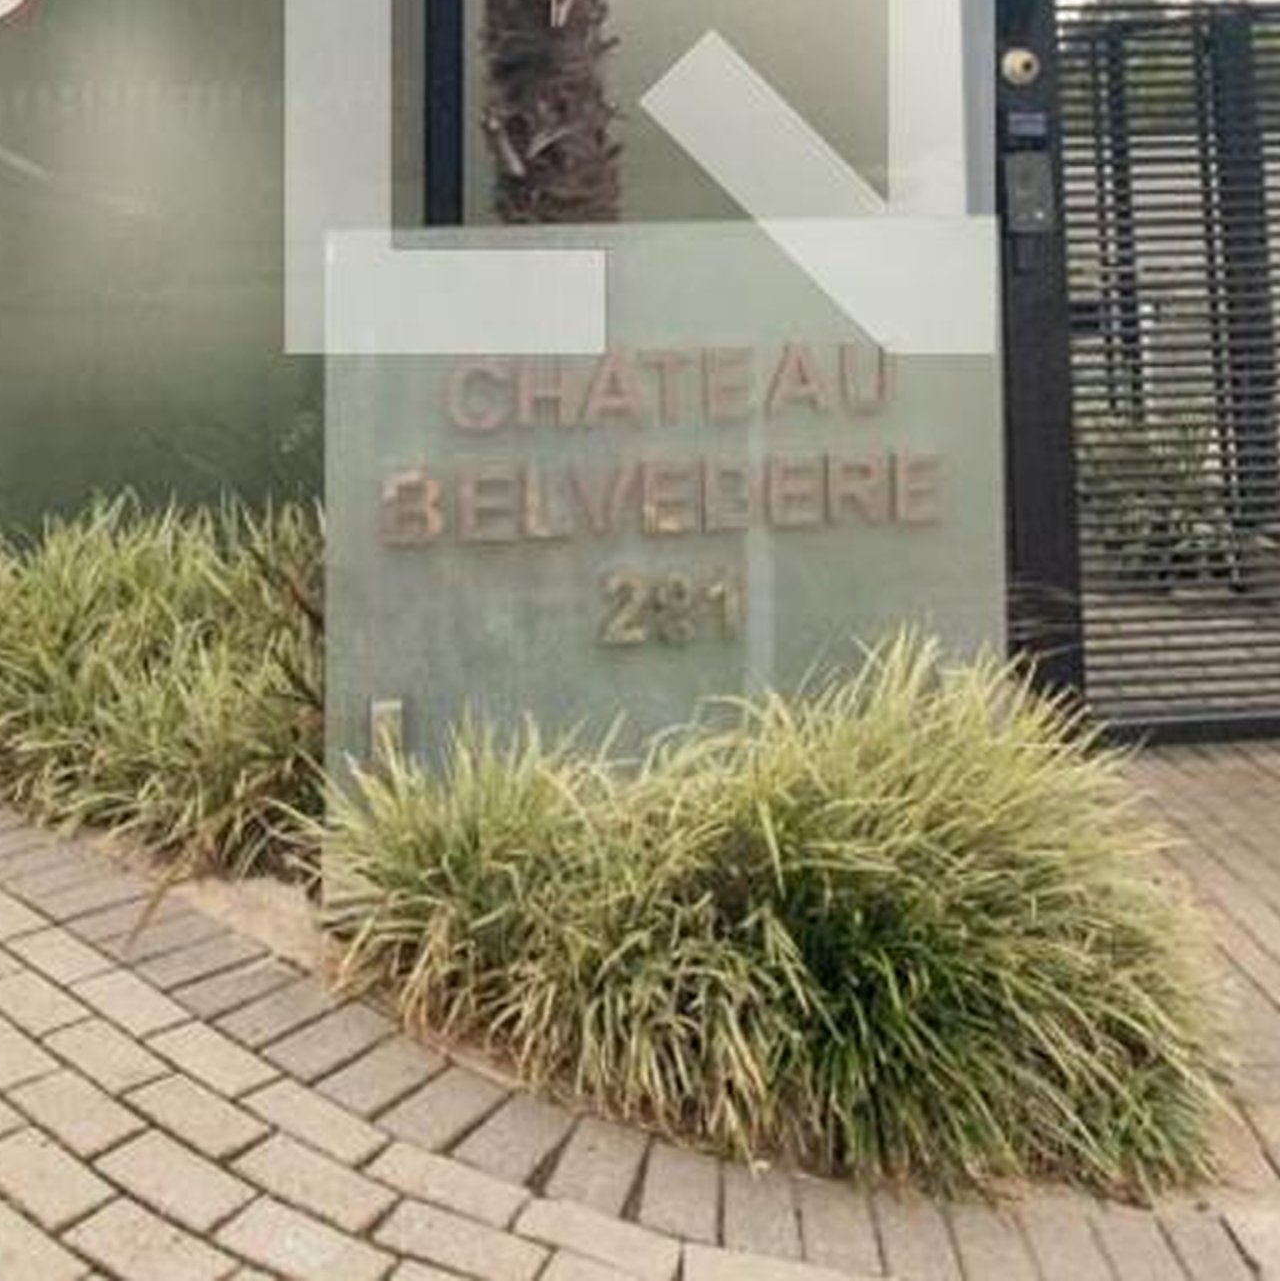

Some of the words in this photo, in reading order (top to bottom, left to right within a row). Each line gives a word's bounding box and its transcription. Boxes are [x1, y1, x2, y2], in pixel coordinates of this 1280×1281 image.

[444, 336, 898, 435] CHATEAU
[377, 448, 944, 548] BELVEDERE
[598, 569, 747, 646] 281
